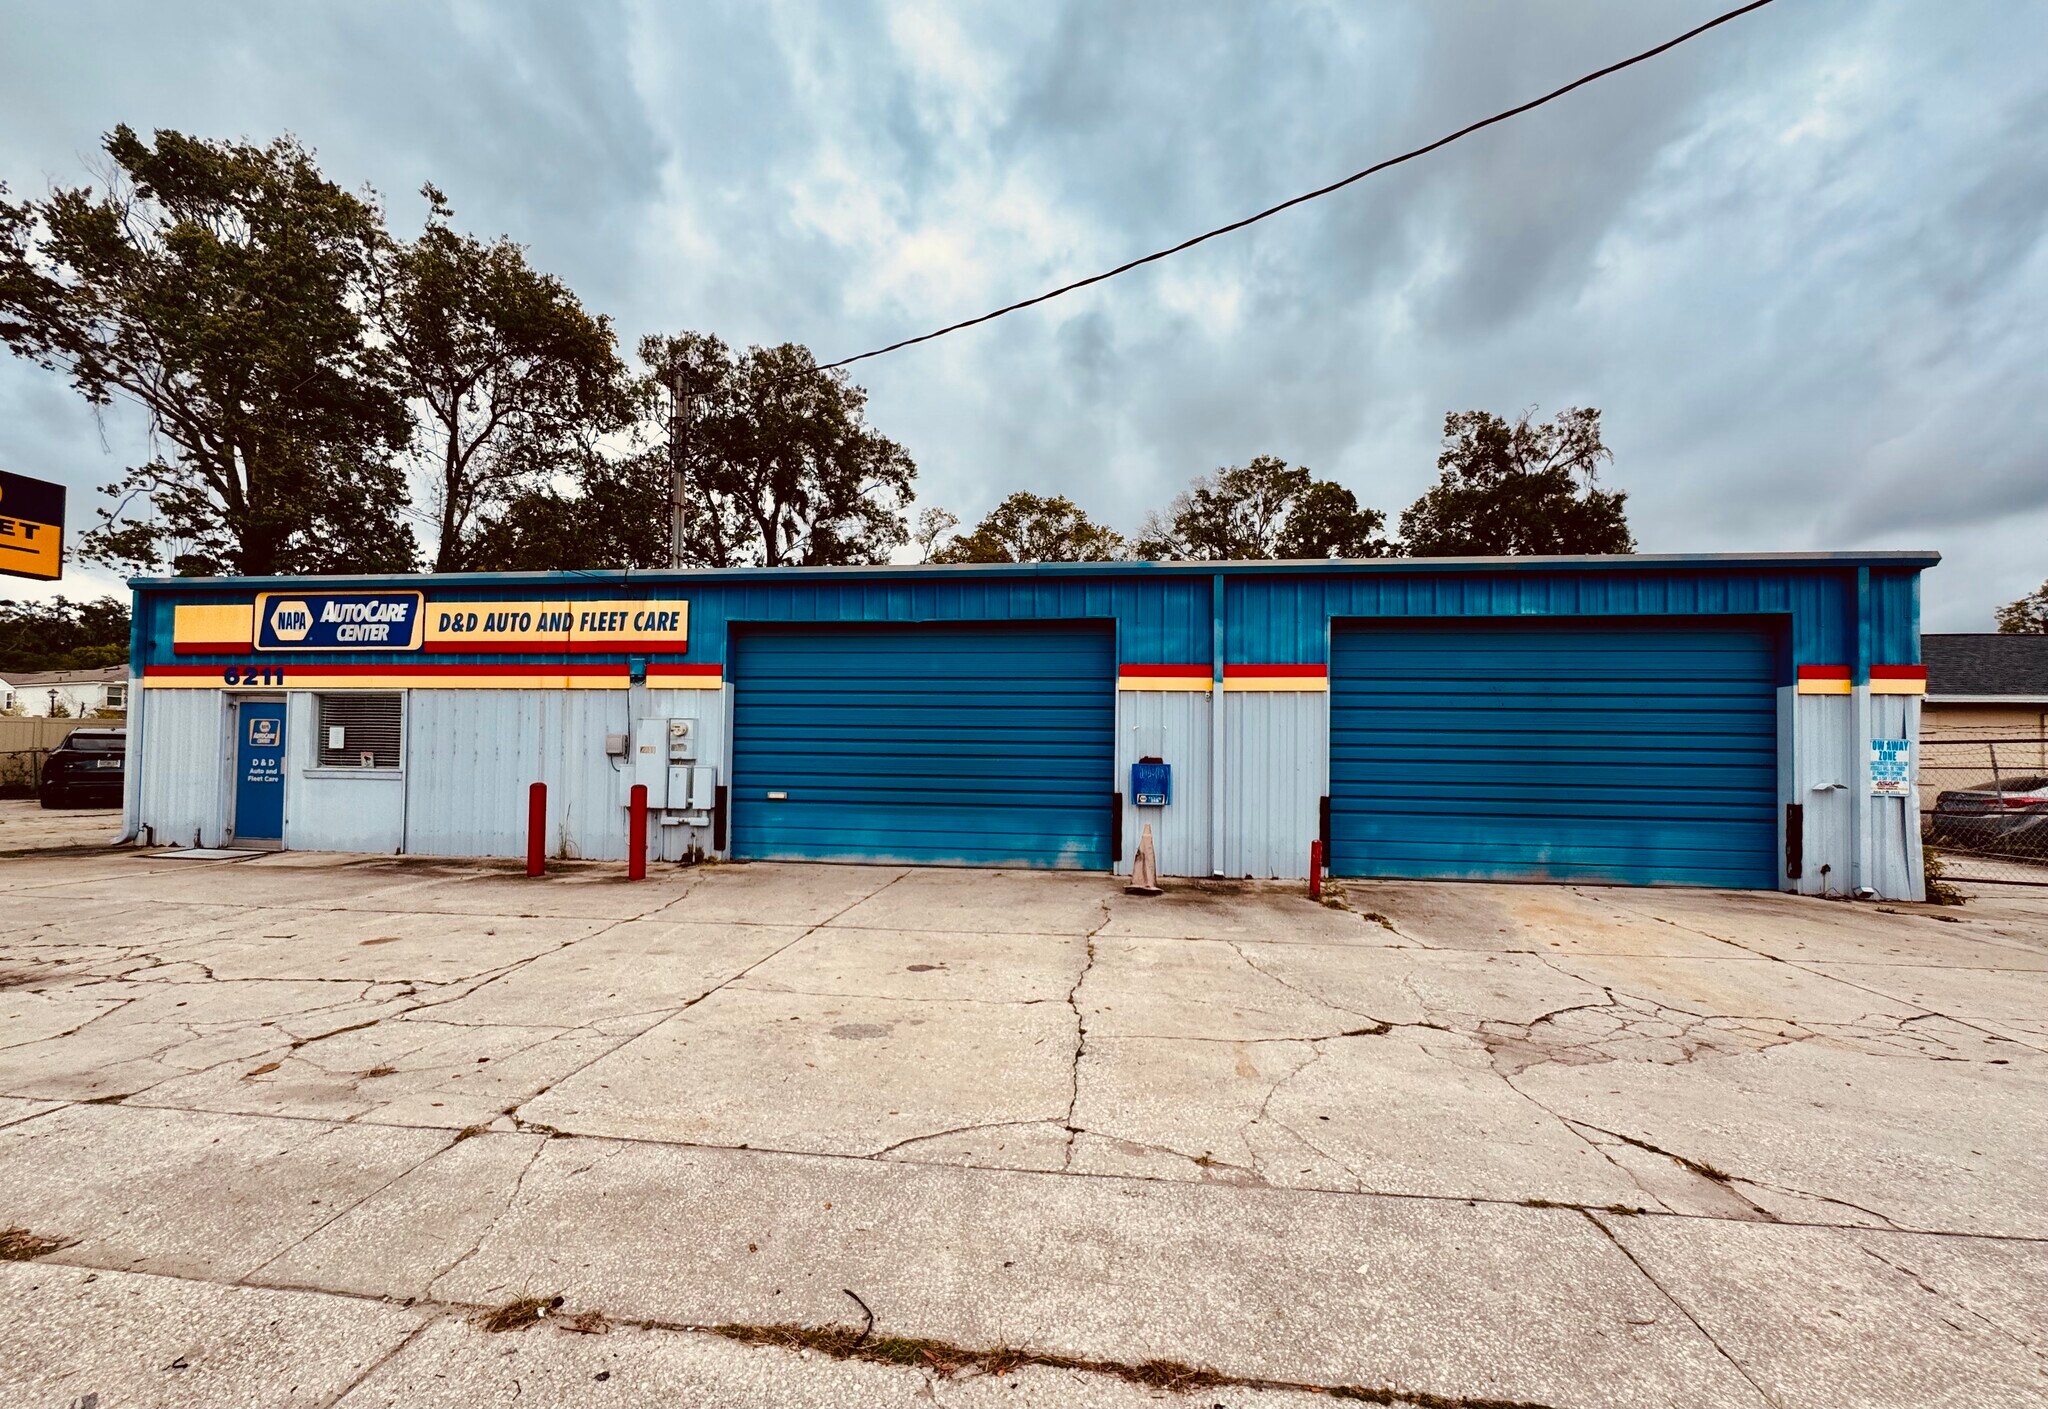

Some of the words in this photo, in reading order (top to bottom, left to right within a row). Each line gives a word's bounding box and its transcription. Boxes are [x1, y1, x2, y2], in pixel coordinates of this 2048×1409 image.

[277, 611, 307, 631] NAPA
[438, 612, 479, 633] D&D
[483, 612, 532, 633] AUTO
[536, 612, 575, 632] AND
[579, 611, 629, 632] FLEET
[633, 611, 681, 632] CARE
[336, 624, 390, 642] CENTER
[223, 667, 285, 686] 6211
[1872, 740, 1884, 750] OW
[1886, 740, 1909, 751] AWAY
[1878, 750, 1897, 761] ZONE
